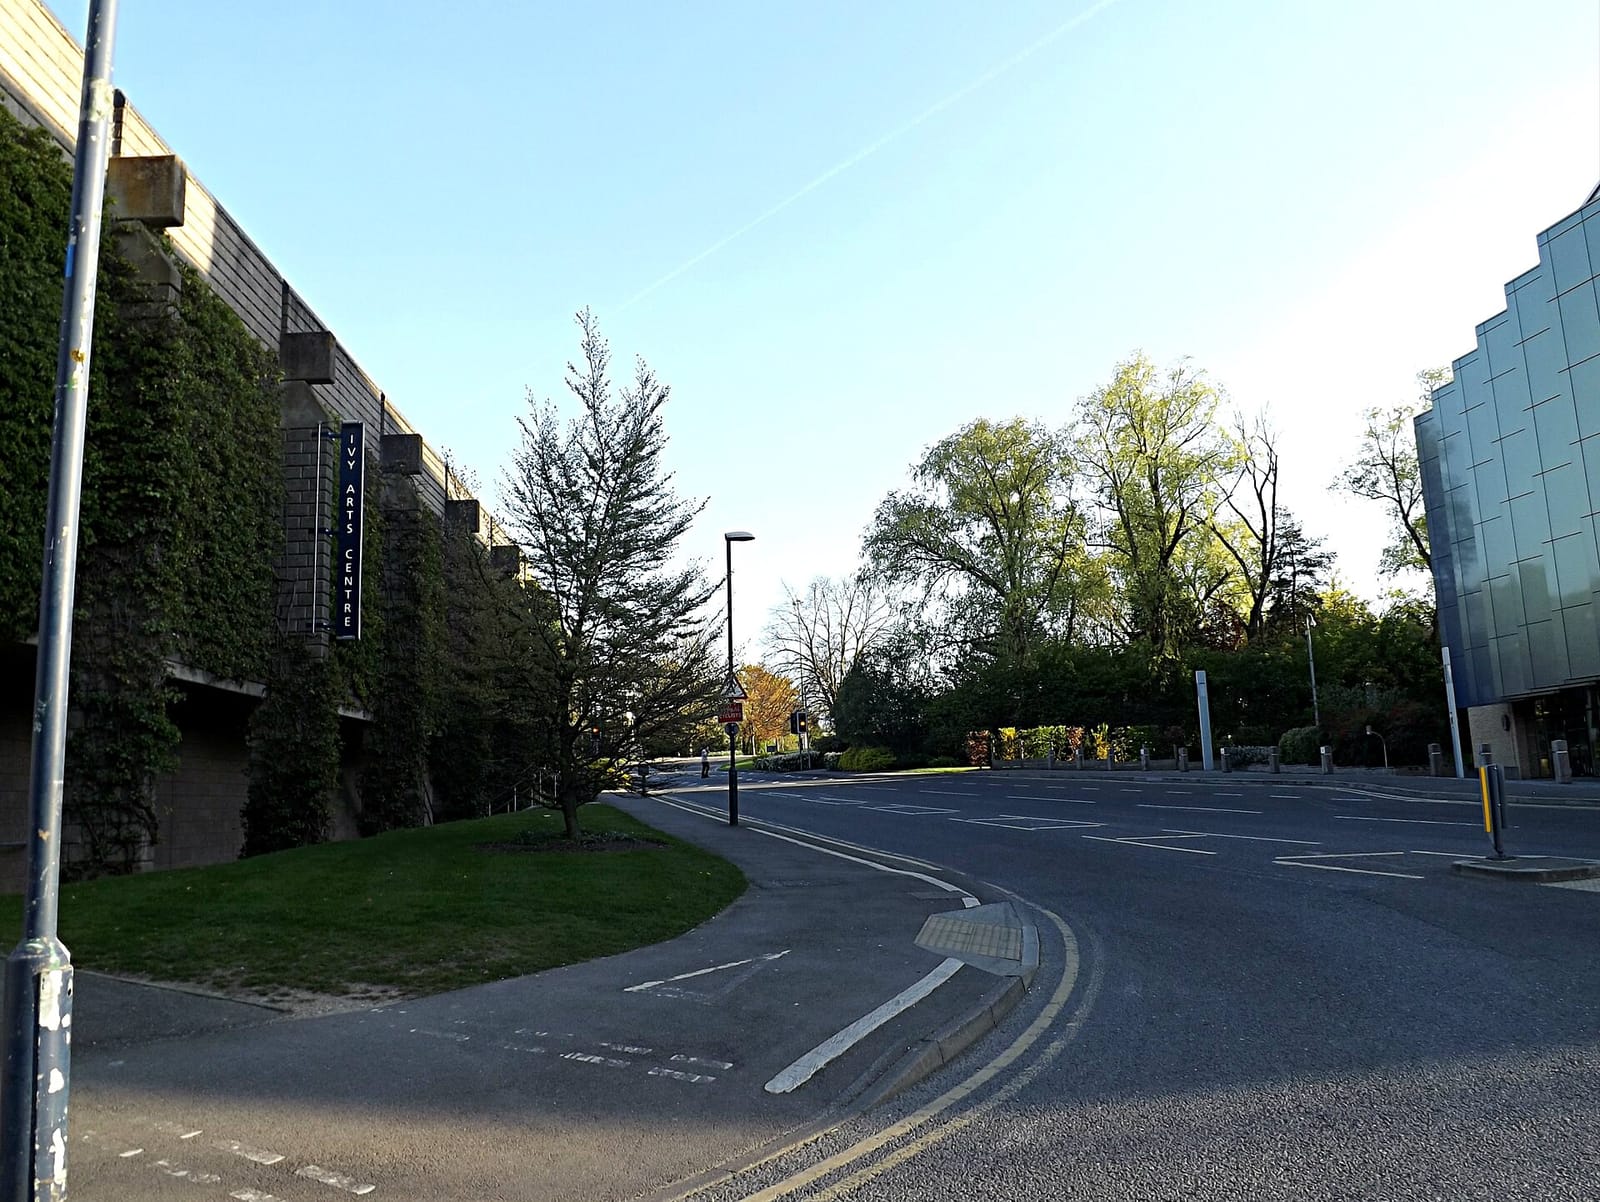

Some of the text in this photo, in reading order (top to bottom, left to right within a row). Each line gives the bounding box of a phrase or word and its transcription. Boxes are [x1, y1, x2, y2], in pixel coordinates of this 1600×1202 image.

[344, 434, 357, 627] IVY ARTS CENTRE
